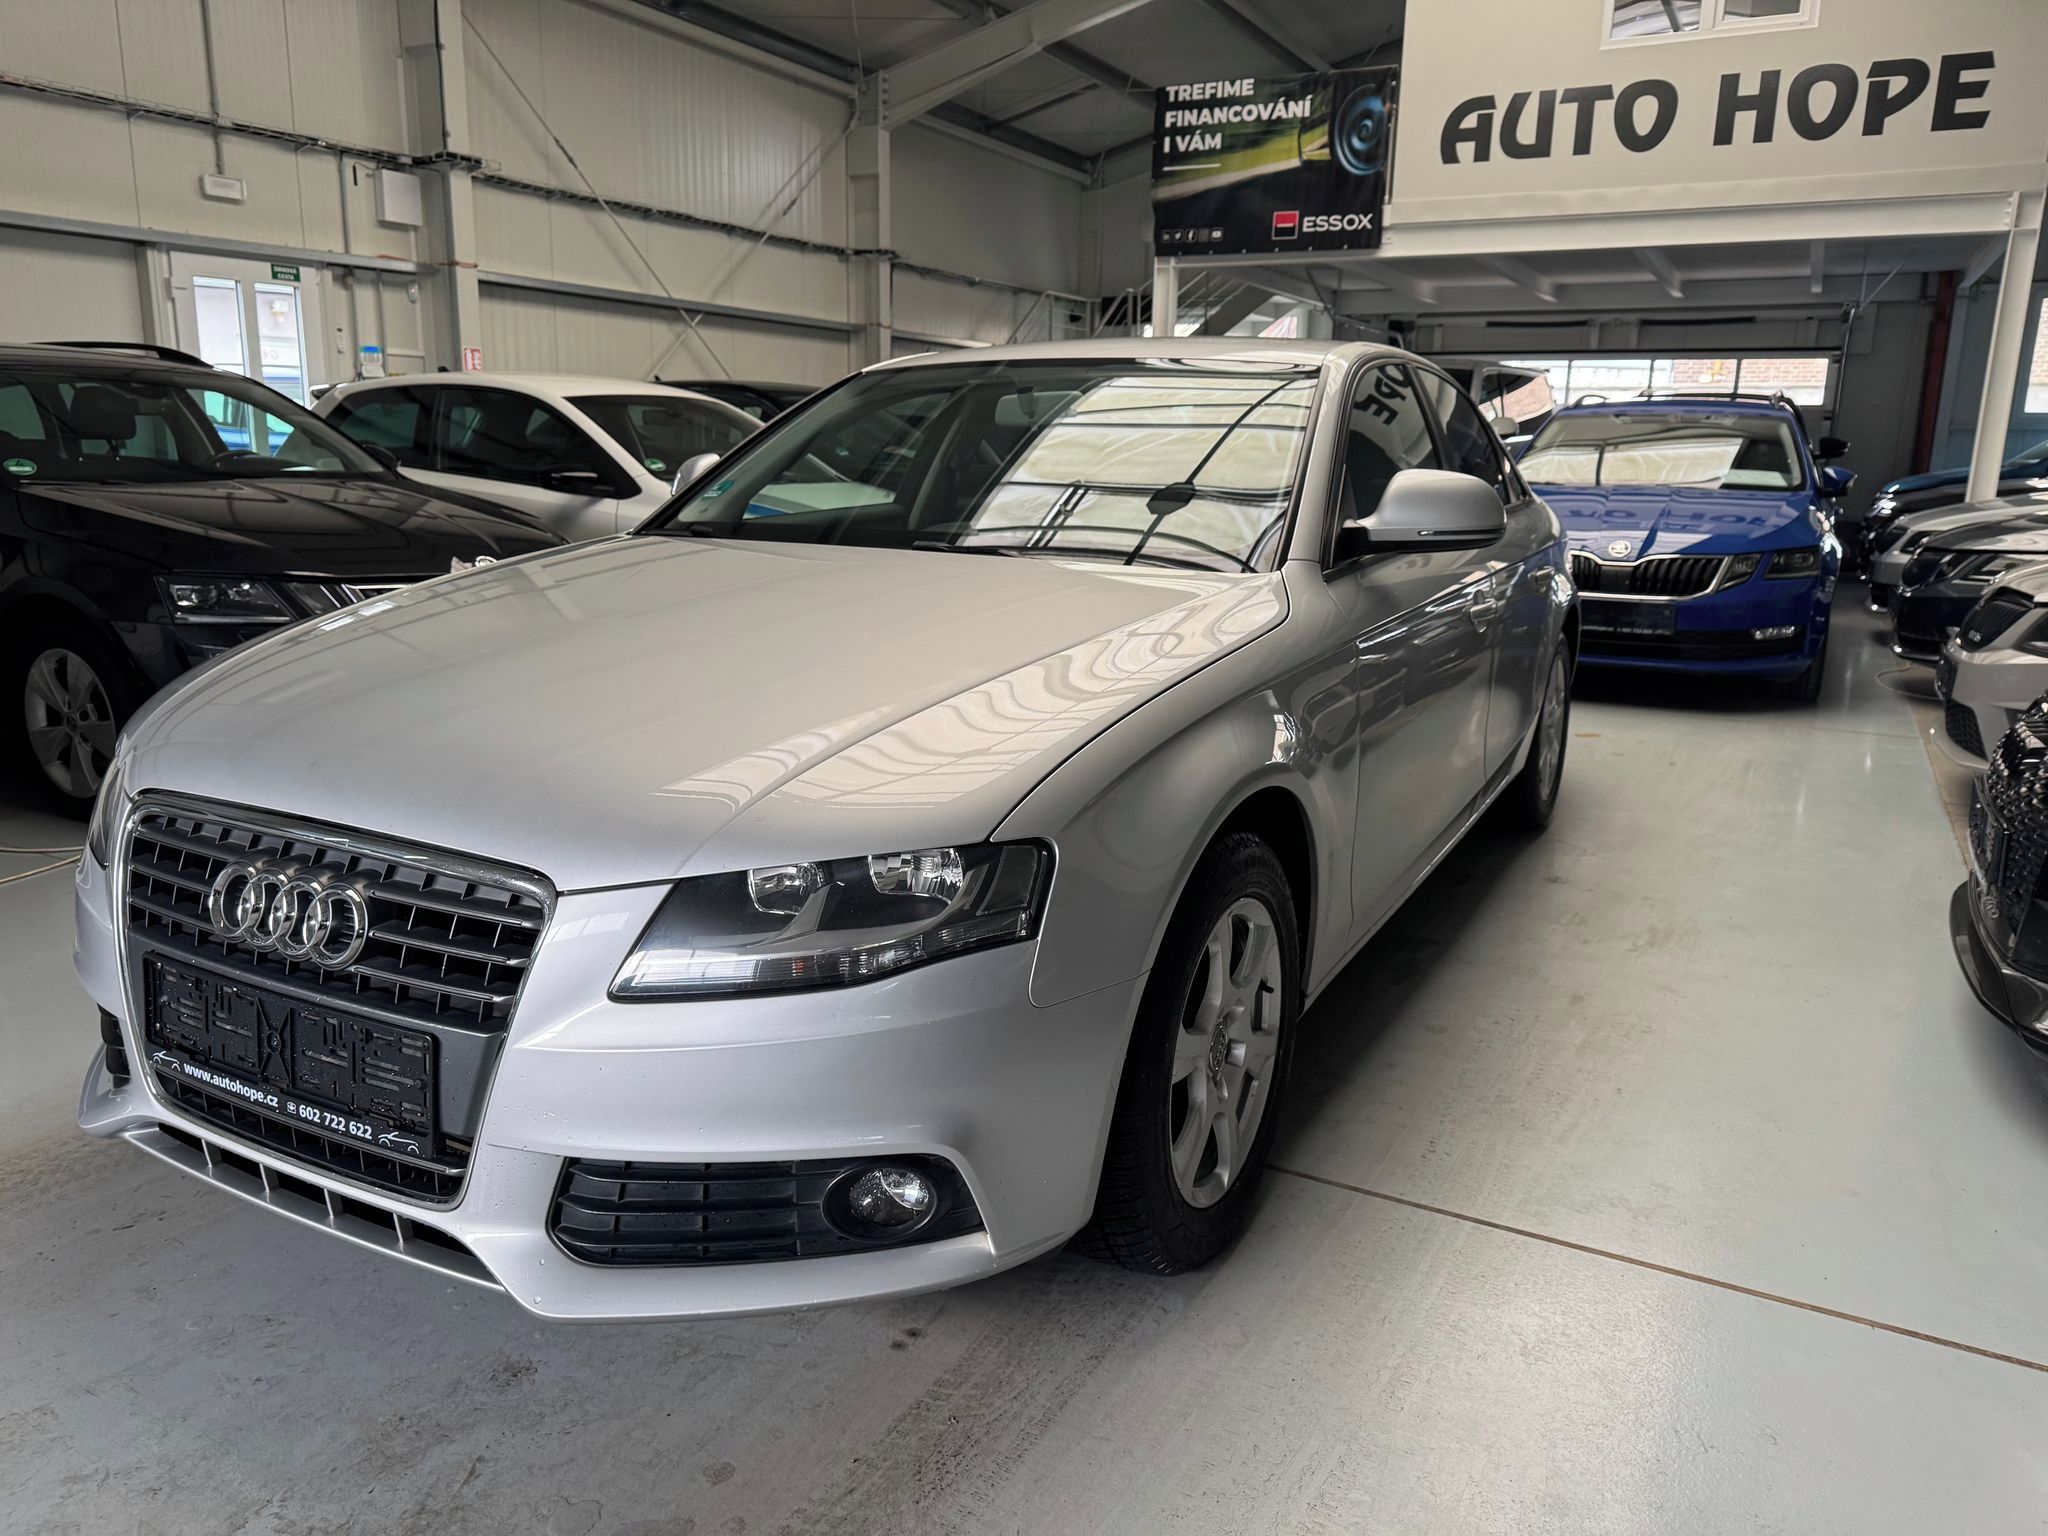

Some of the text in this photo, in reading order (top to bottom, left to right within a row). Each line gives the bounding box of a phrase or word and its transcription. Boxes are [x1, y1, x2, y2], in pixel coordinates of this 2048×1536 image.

[1166, 78, 1255, 102] TREFIME
[1164, 95, 1313, 128] FINANCOVÁNÍ
[1440, 50, 1996, 165] AUTO HOPE
[1163, 129, 1222, 153] I VÁM
[1302, 213, 1373, 232] ESSOX
[183, 1063, 372, 1139] www.autohope.cz 602 722 622
